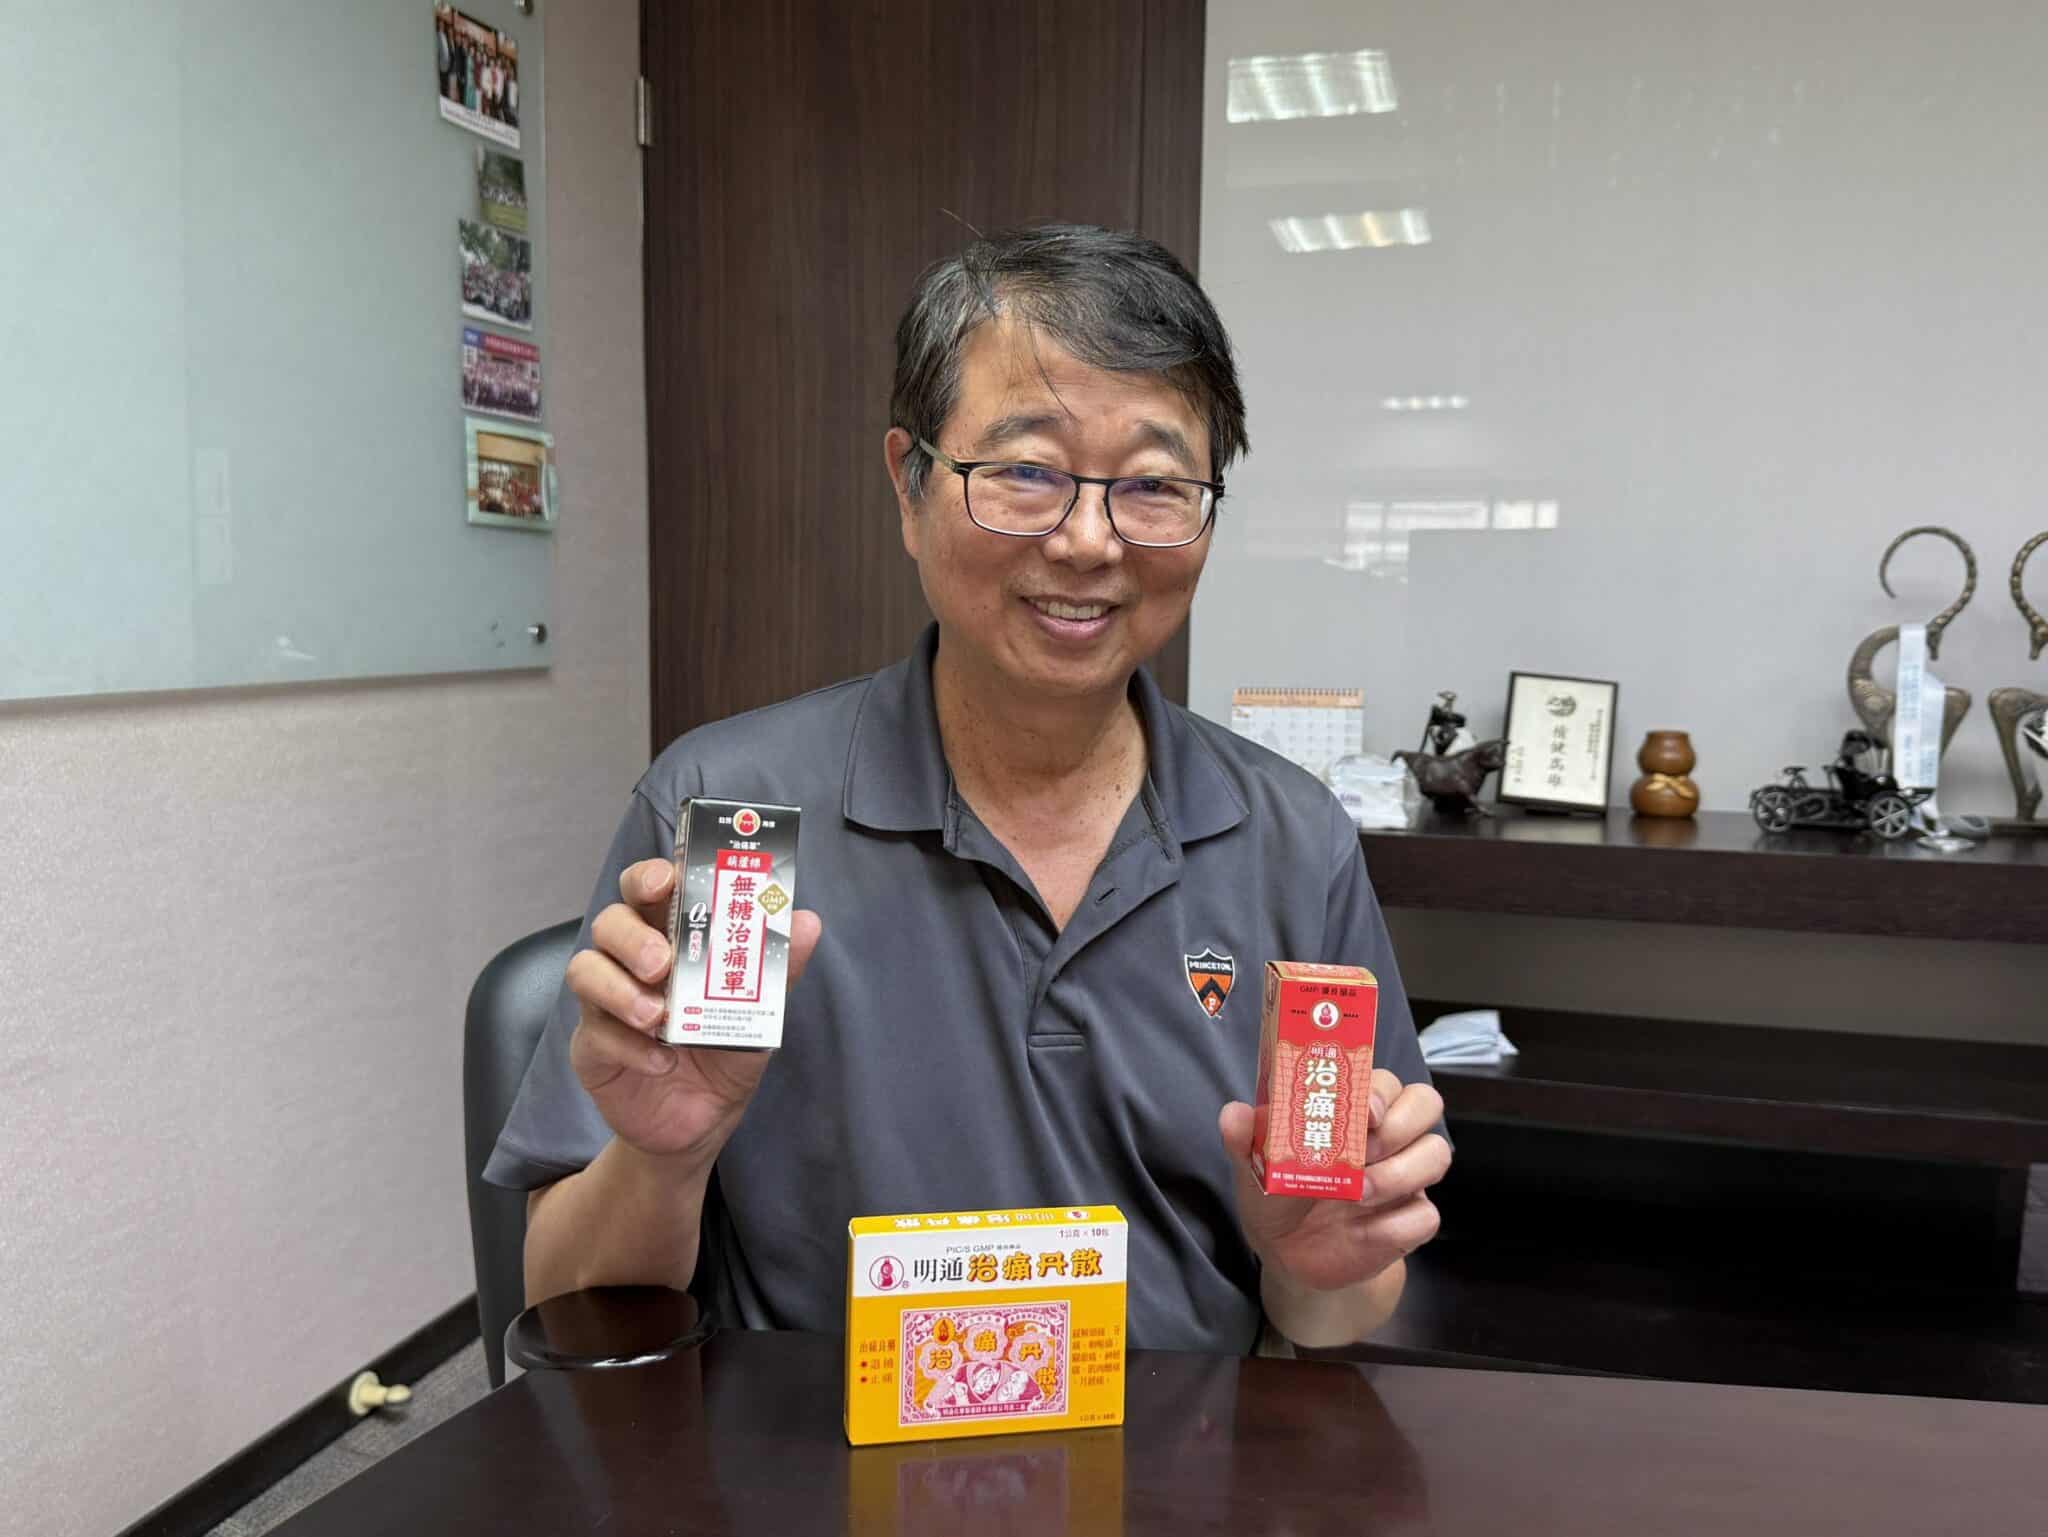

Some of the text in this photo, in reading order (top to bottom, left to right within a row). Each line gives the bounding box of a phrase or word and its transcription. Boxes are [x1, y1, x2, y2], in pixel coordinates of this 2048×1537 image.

[721, 874, 757, 996] 無糖治痛單
[1311, 1046, 1337, 1058] 明通
[1303, 1059, 1338, 1151] 治痛單
[972, 1244, 995, 1253] GMP
